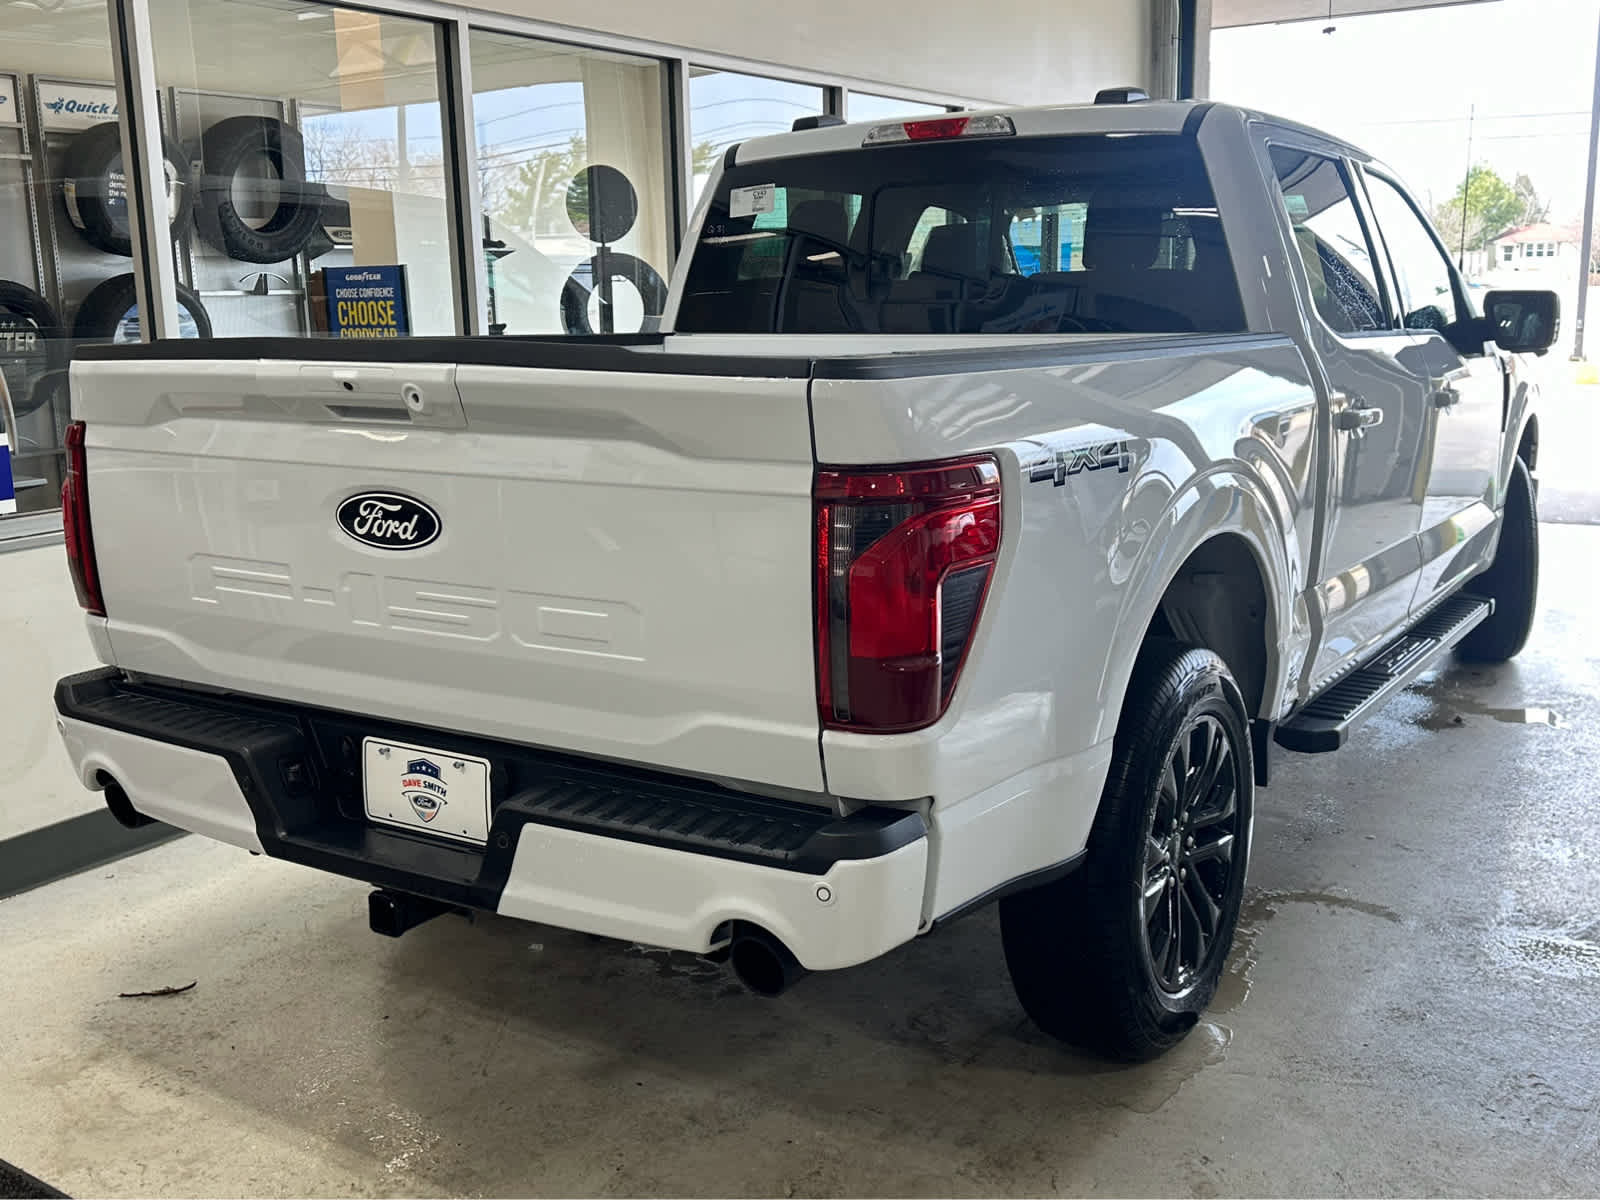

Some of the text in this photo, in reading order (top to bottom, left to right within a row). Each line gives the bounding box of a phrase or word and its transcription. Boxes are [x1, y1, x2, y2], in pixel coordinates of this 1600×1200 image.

[65, 99, 110, 114] Quick
[345, 272, 381, 281] GOODYEAR
[336, 287, 394, 298] CHOOSE CONFIDENCE
[338, 301, 396, 326] CHOOSE
[354, 501, 419, 541] Ford
[402, 779, 447, 797] DAVE SMITH
